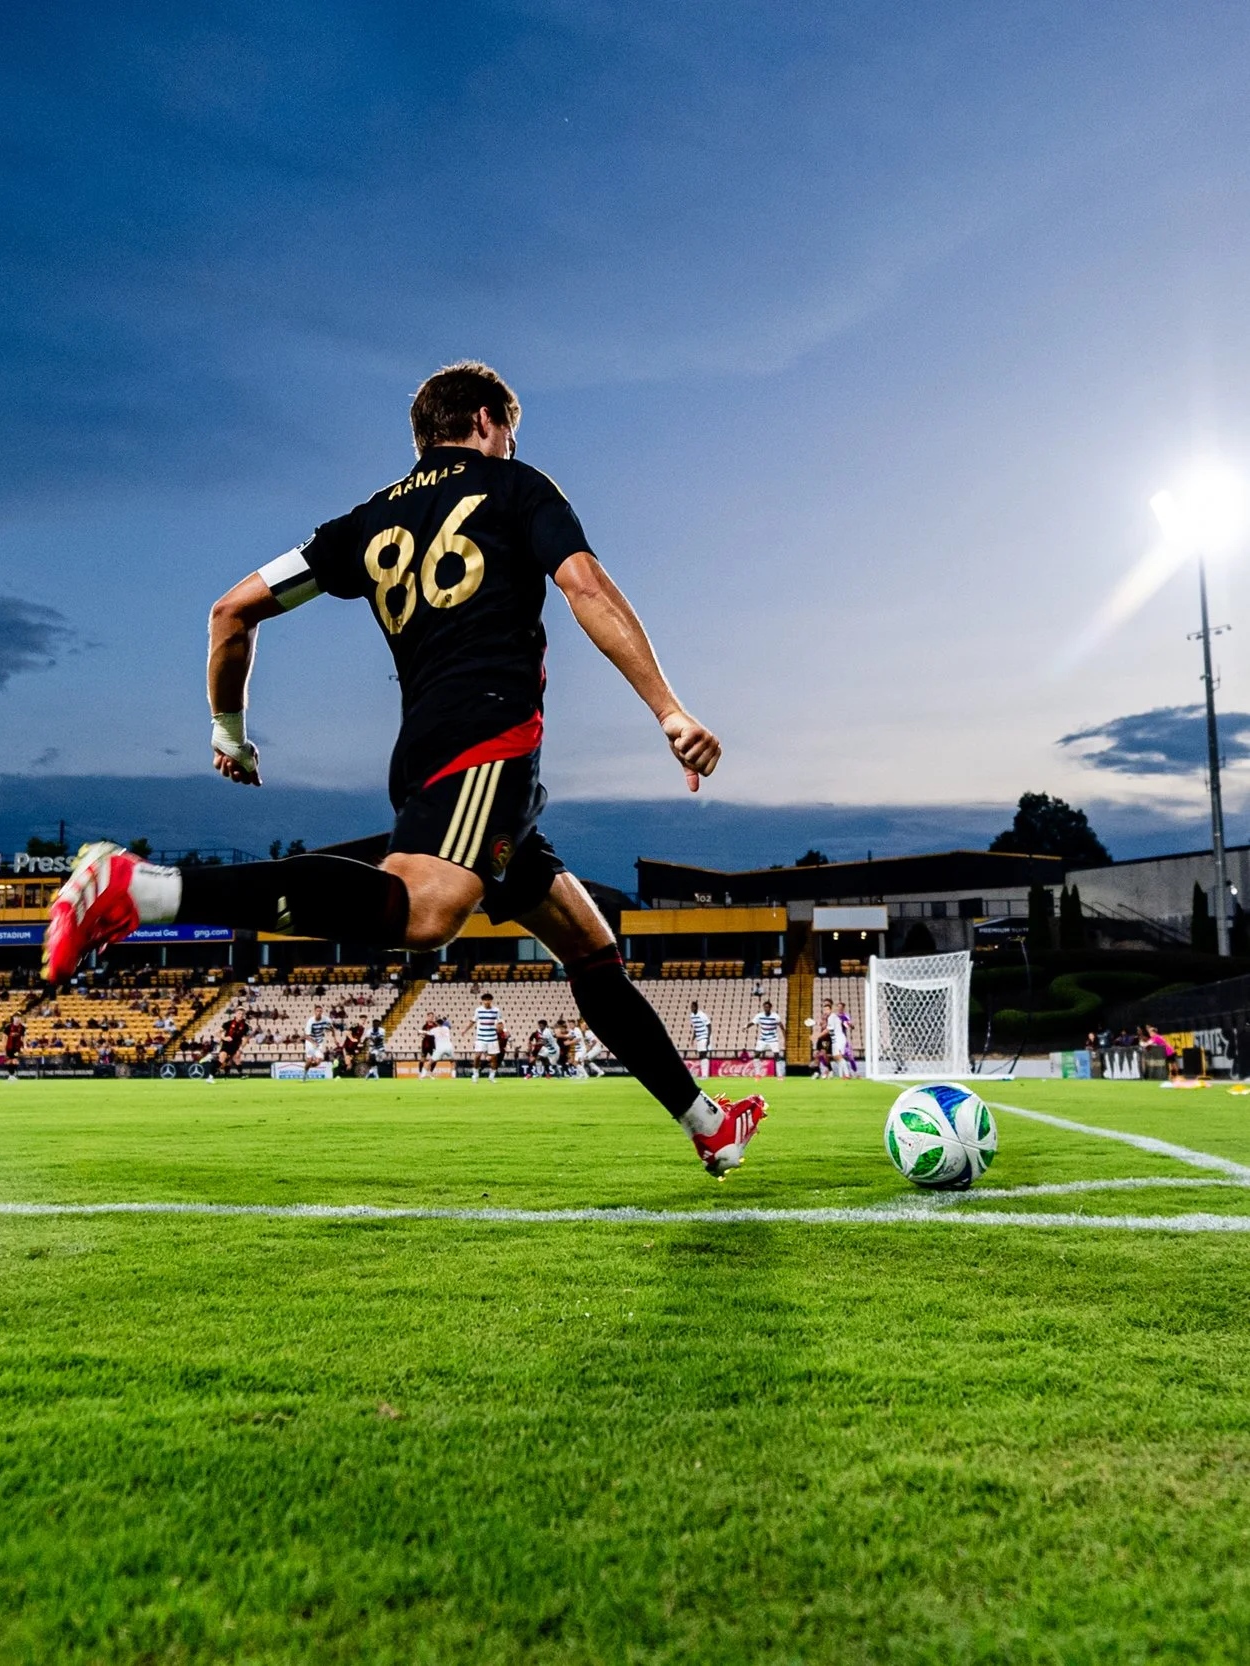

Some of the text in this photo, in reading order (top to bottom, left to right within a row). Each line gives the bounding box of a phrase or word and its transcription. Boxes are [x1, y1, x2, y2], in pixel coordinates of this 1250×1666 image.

[388, 461, 467, 501] ARMAS
[364, 494, 488, 635] 86
[0, 931, 31, 940] STADIUM
[133, 930, 162, 938] Natural
[163, 929, 178, 937] Gas
[194, 929, 229, 938] gng.com
